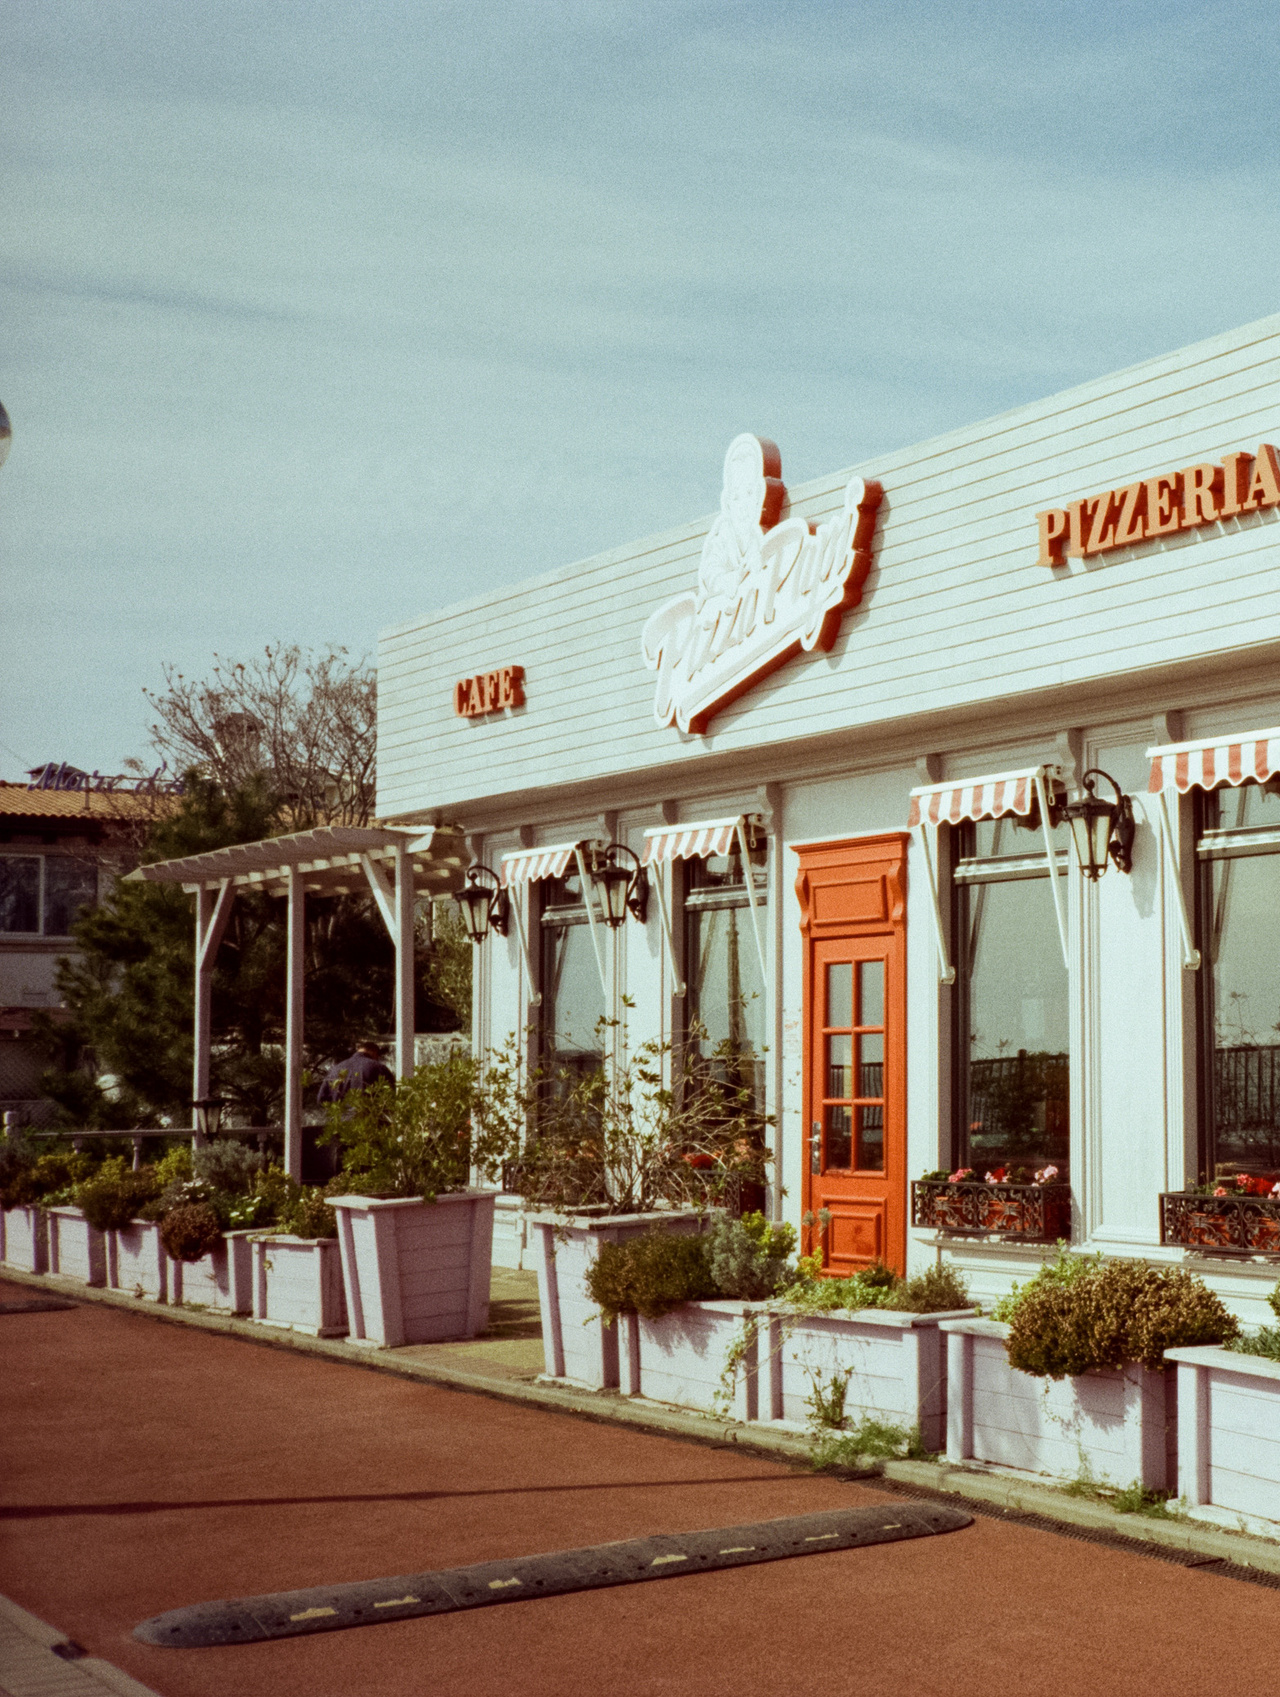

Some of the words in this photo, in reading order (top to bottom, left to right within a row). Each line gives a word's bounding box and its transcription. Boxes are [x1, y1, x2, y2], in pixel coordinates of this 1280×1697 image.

[644, 586, 762, 719] Pizza
[761, 481, 863, 641] Papi
[453, 665, 523, 718] CAFE
